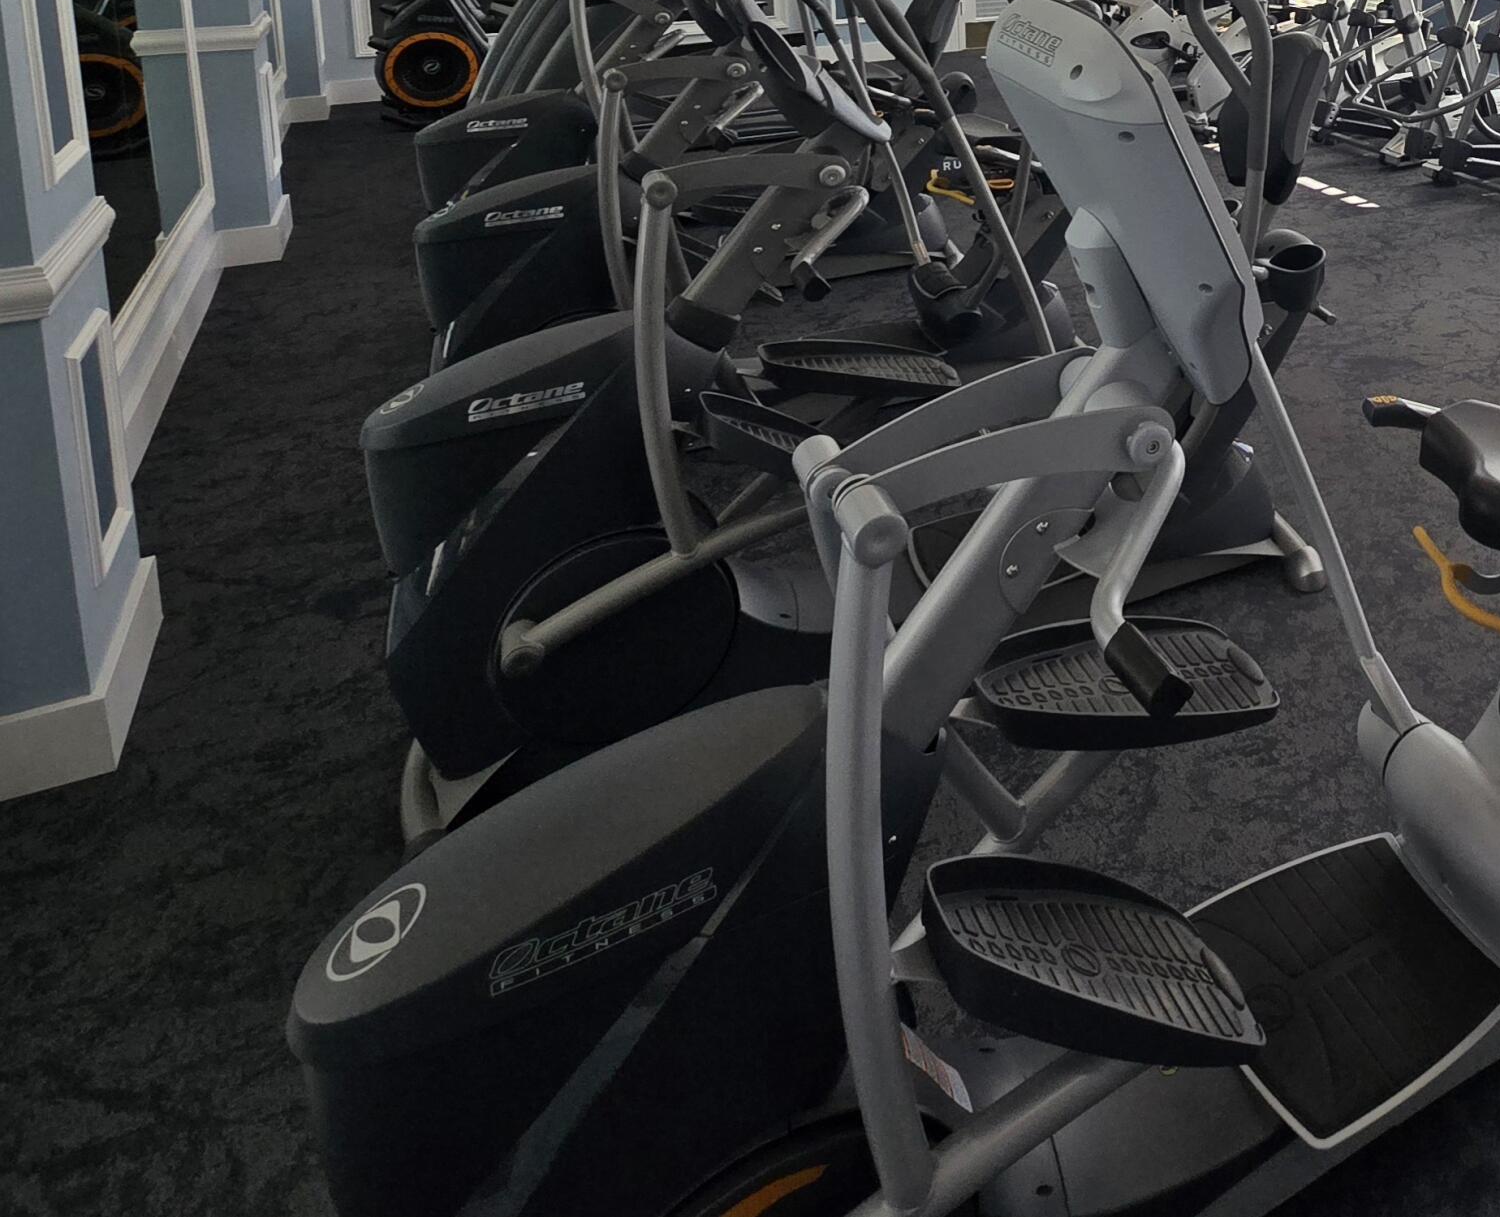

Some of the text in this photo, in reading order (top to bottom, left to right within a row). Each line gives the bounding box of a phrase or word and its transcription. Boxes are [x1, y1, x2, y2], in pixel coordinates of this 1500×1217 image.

[1001, 12, 1063, 54] Octane
[466, 117, 528, 129] Octane
[484, 205, 564, 222] Octane
[467, 381, 585, 414] Octane
[489, 866, 714, 980] Octane
